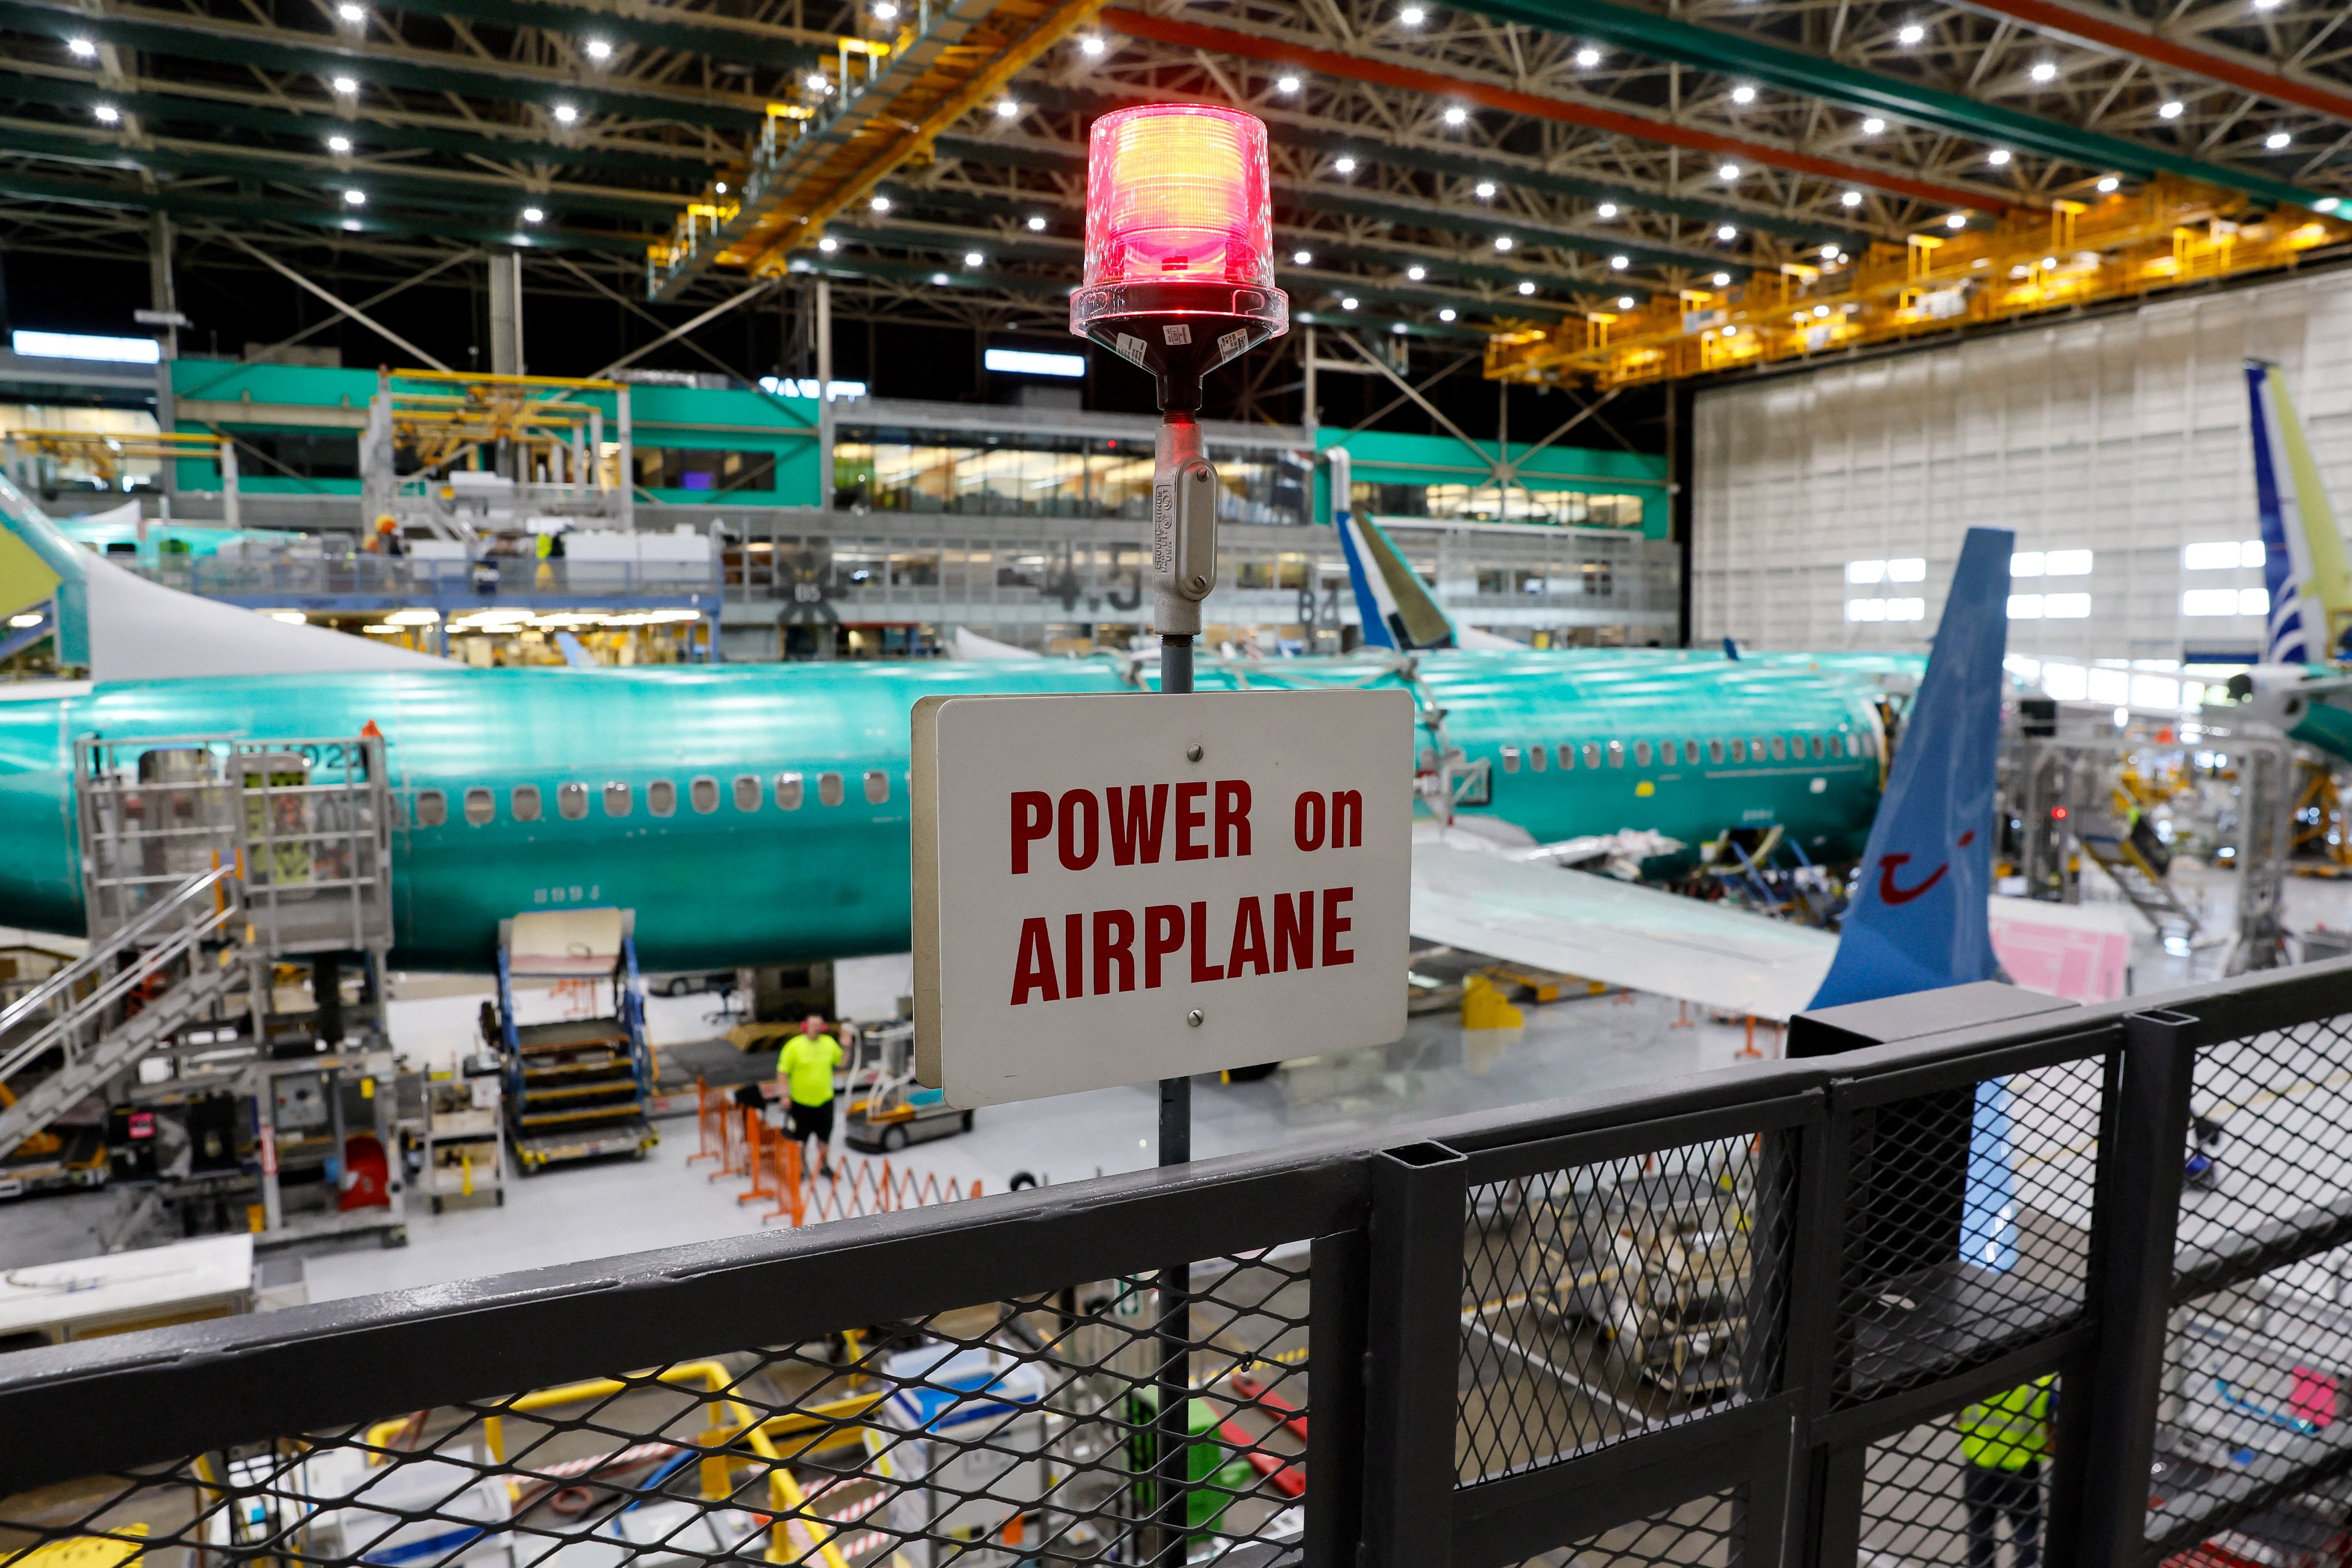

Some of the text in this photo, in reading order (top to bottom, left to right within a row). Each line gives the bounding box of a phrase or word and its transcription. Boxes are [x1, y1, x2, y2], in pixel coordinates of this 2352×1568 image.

[1011, 780, 1362, 874] POWER on
[1010, 887, 1354, 1005] AIRPLANE
